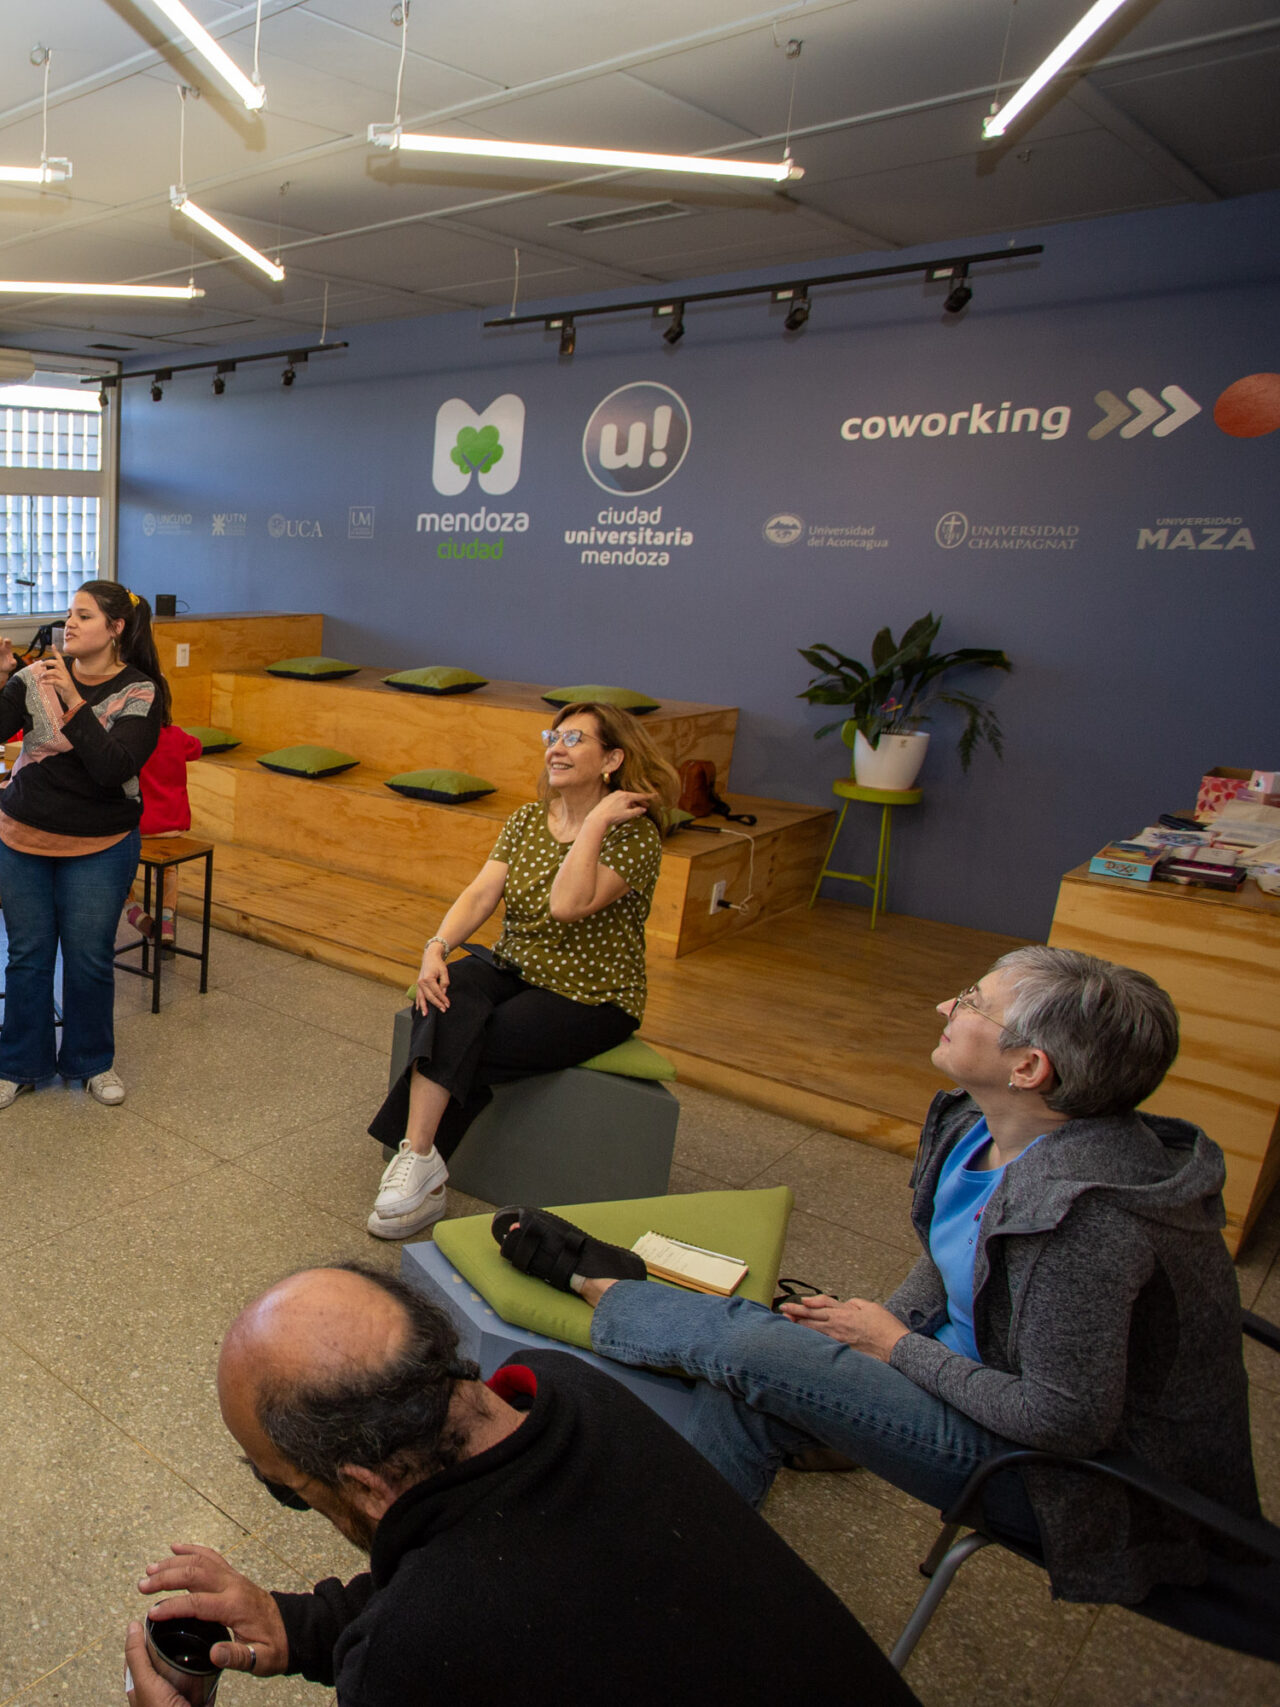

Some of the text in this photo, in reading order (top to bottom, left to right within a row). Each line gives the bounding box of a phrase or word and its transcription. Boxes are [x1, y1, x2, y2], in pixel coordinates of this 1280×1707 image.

[840, 402, 1071, 440] coworking
[600, 405, 673, 469] u!
[225, 512, 248, 523] UTN
[351, 511, 371, 527] UM
[417, 507, 530, 533] mendoza
[597, 507, 662, 525] ciudad
[1155, 516, 1243, 526] UNIVERSIDAD
[286, 519, 324, 538] UCA
[564, 526, 694, 547] universitaria
[808, 525, 875, 537] Universidad
[970, 525, 1080, 537] UNIVERSIDAD
[807, 536, 889, 550] del Aconcagua
[968, 538, 1079, 550] CHAMPAGNAT
[1135, 527, 1256, 551] MAZA
[436, 537, 504, 560] ciudad
[580, 546, 670, 567] mendoza
